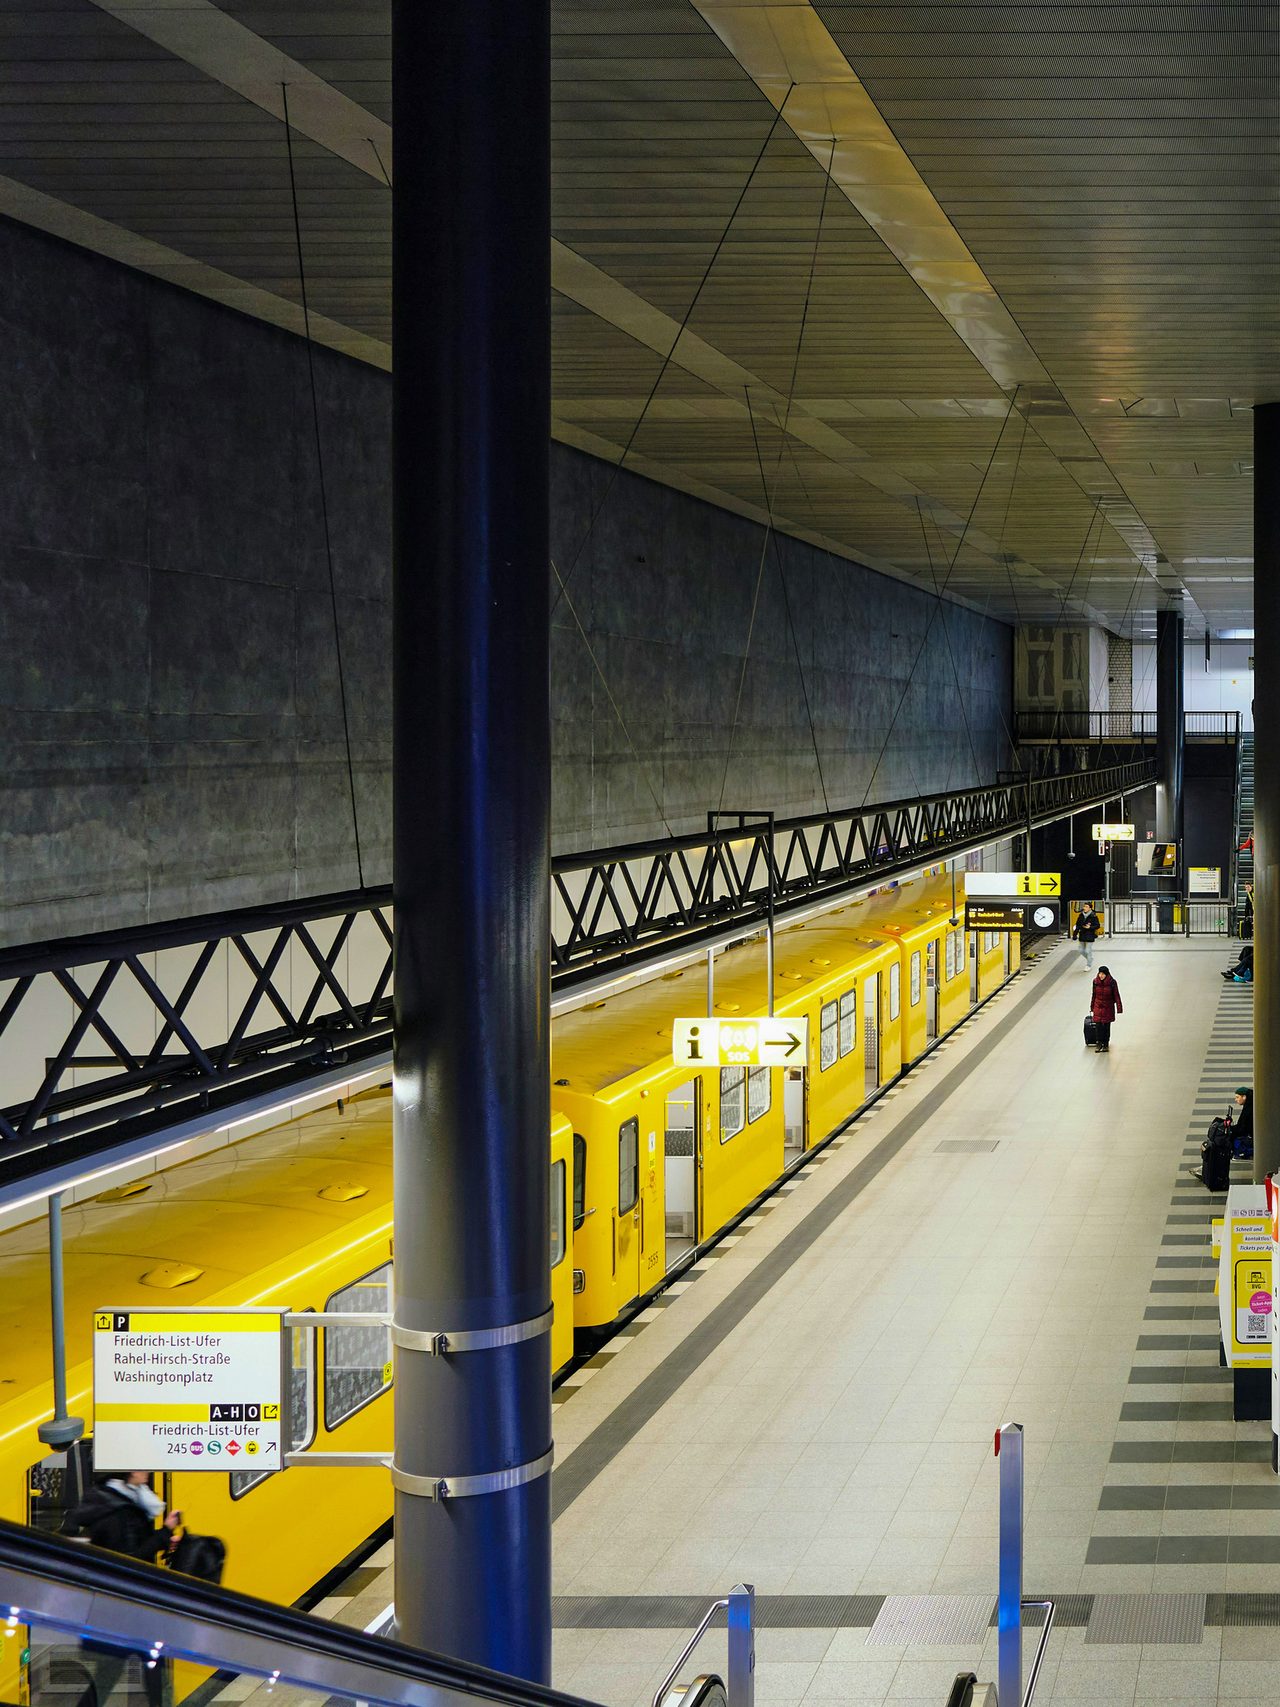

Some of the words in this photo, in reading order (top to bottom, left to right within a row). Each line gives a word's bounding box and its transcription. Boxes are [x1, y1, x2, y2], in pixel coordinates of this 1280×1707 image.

[727, 1051, 750, 1062] SOS
[118, 1316, 126, 1328] P
[114, 1335, 221, 1347] Friedrich-List-Ufer
[114, 1353, 231, 1365] Rahel-Hirsch-Straße
[114, 1371, 213, 1386] Washingtonplatz
[152, 1424, 260, 1436] Friedrich-List-Ufer
[167, 1443, 188, 1454] 245
